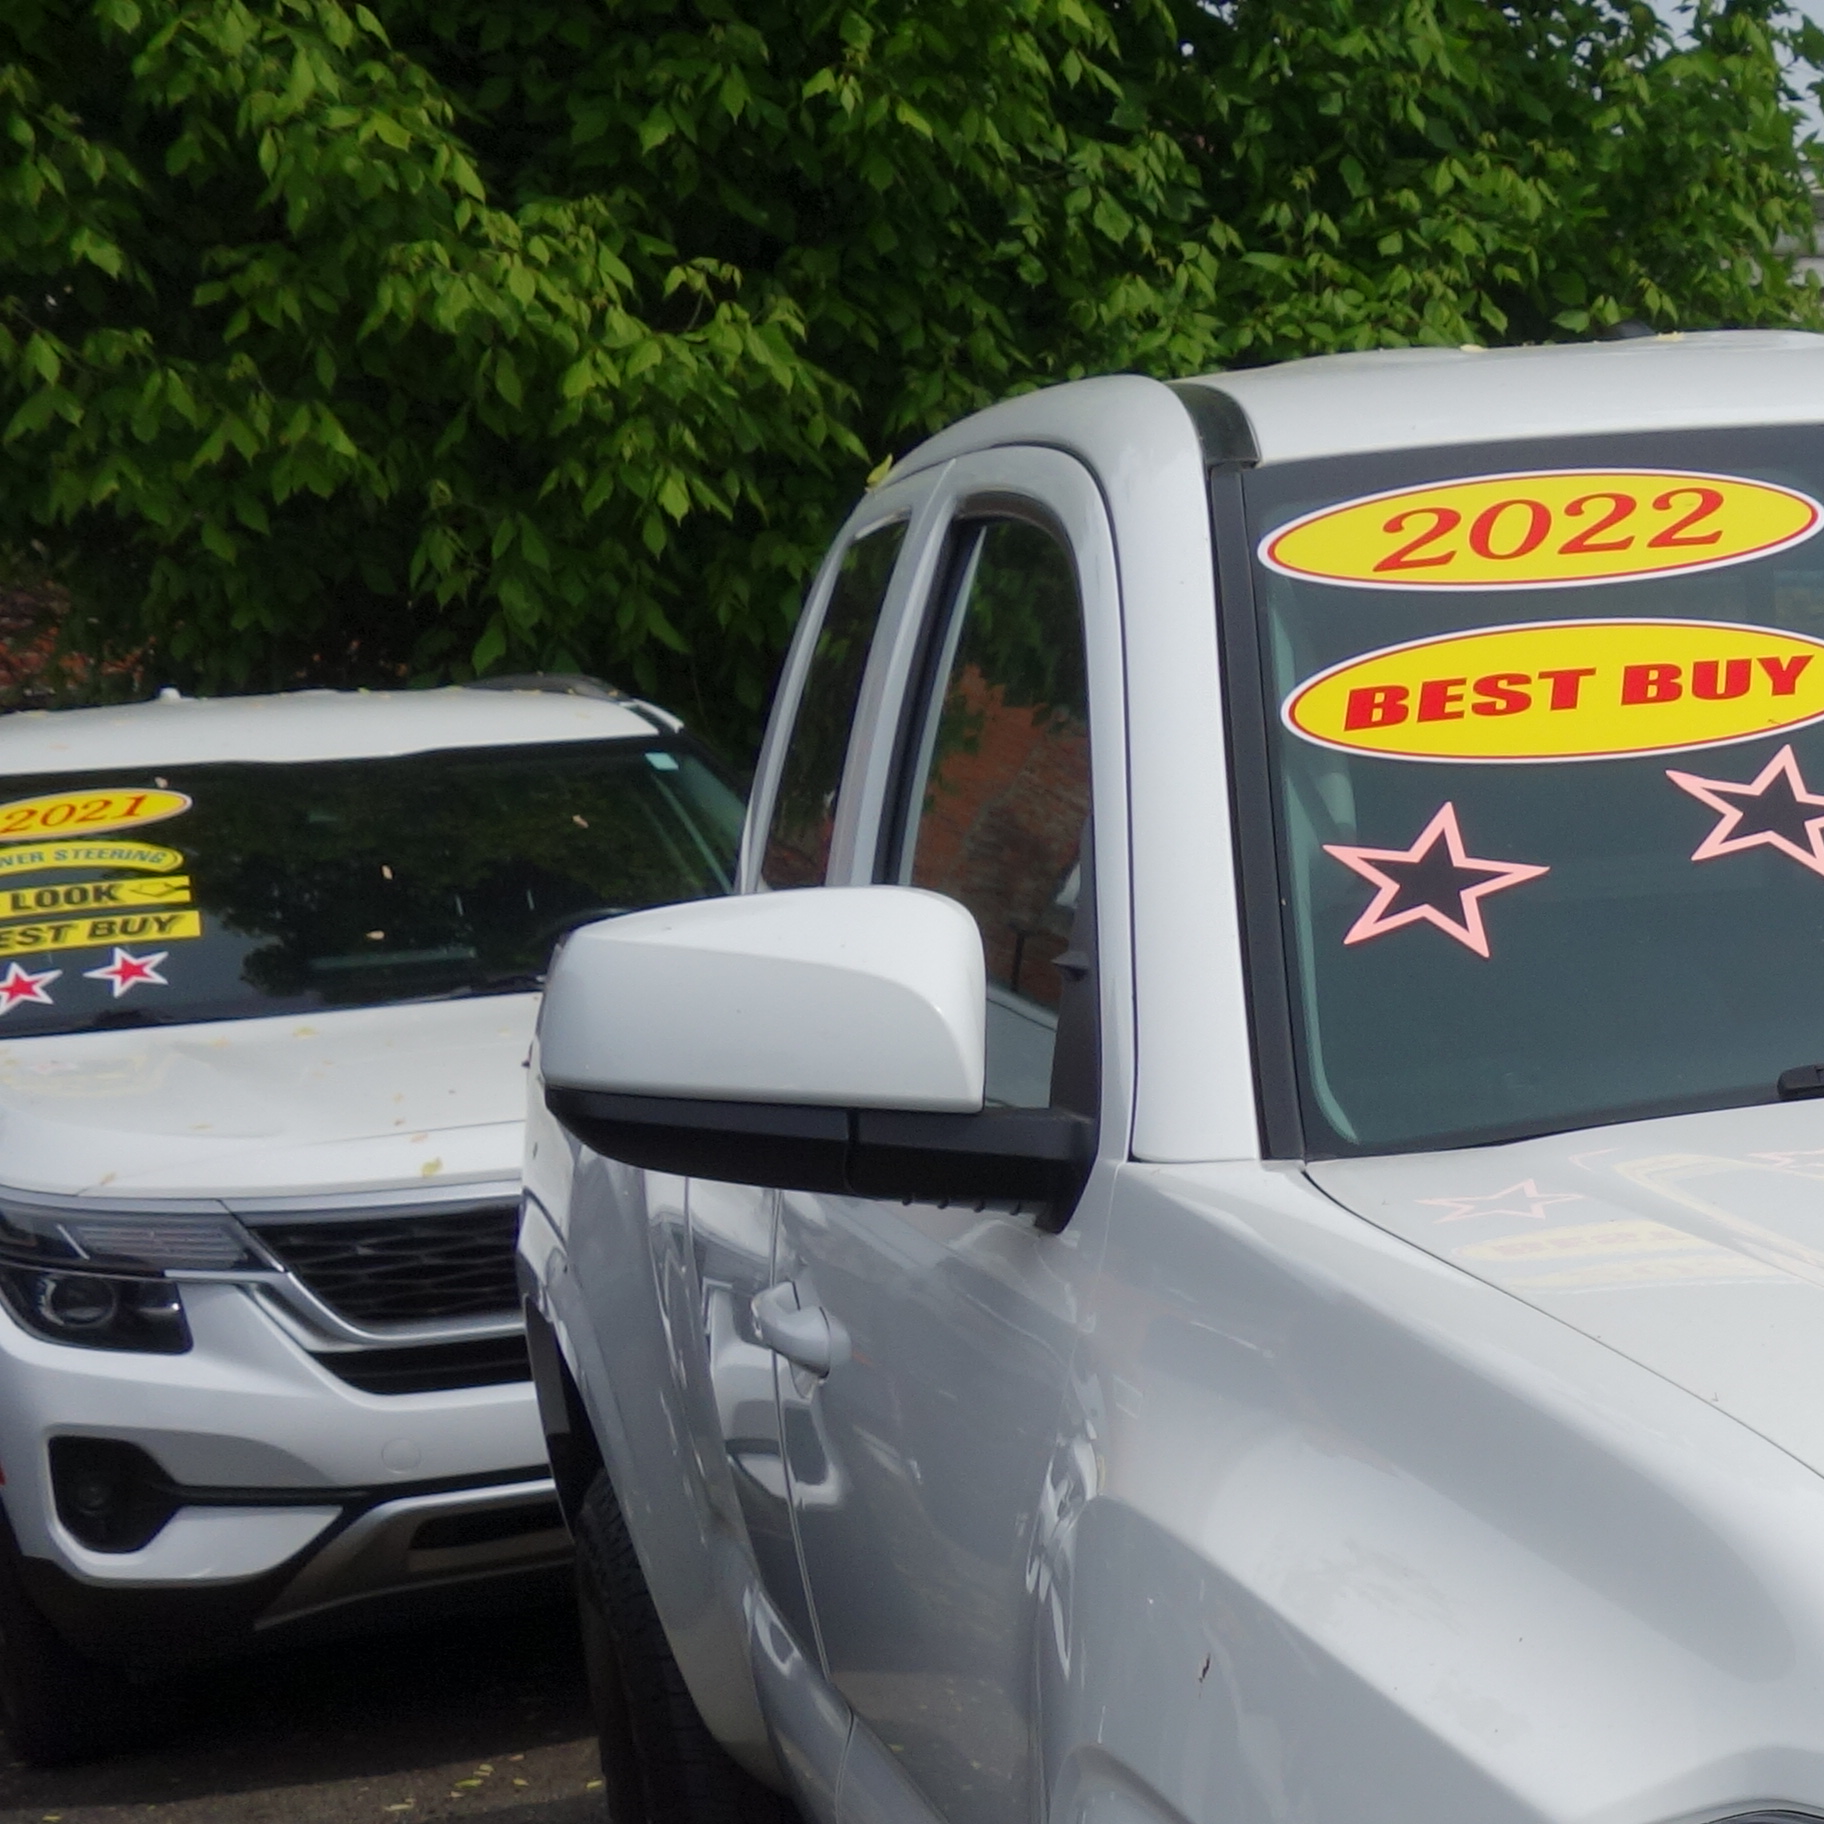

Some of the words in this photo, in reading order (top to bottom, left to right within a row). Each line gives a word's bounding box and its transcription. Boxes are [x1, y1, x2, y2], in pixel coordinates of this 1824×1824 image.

[1373, 487, 1725, 573] 2022
[1343, 666, 1597, 732] BEST
[1620, 655, 1815, 706] BUY
[0, 795, 148, 834] 2021
[53, 848, 169, 864] STEERING
[10, 883, 124, 912] LOOK
[87, 914, 186, 939] BUY
